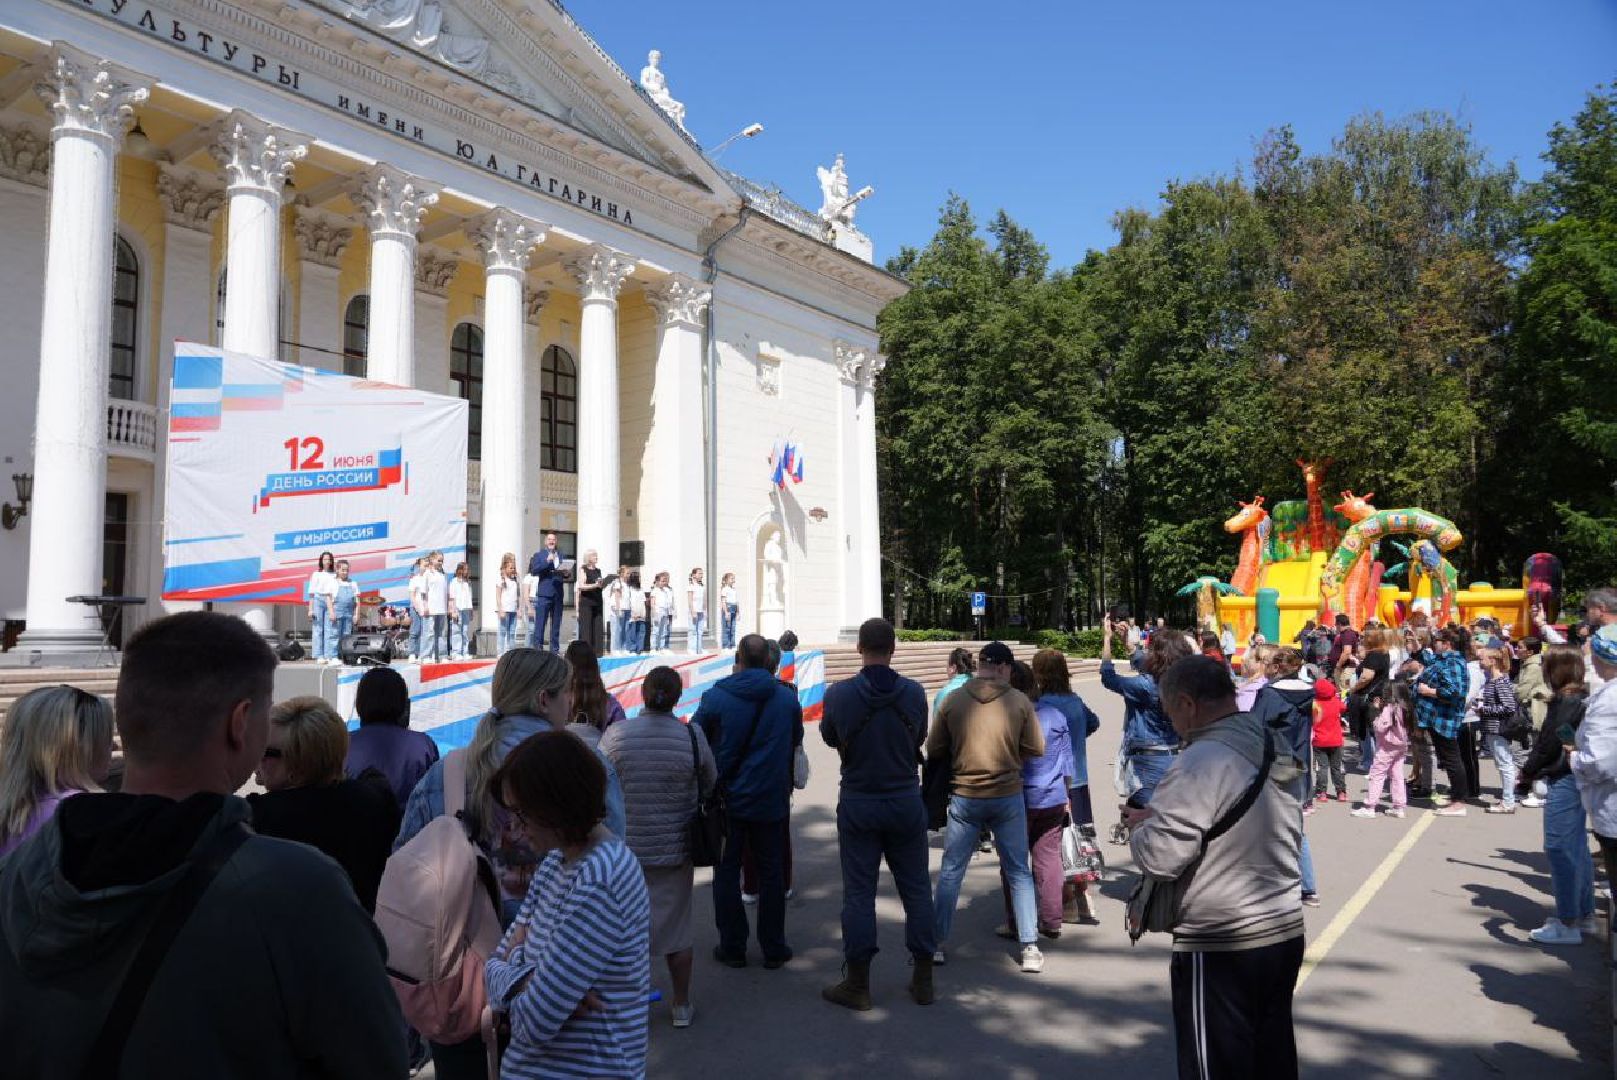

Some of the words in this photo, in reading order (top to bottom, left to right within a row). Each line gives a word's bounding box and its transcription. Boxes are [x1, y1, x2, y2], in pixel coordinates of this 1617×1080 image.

[82, 0, 299, 89] УЛЬТУРЫ
[338, 95, 423, 141] ИМЕНИ
[516, 164, 632, 224] ГАГАРИНА
[284, 436, 324, 471] 12
[333, 456, 373, 468] ИЮНЯ
[272, 476, 312, 491] ДЕНЬ
[317, 471, 373, 486] РОССИИ
[293, 527, 374, 545] #МЫРОССИЯ
